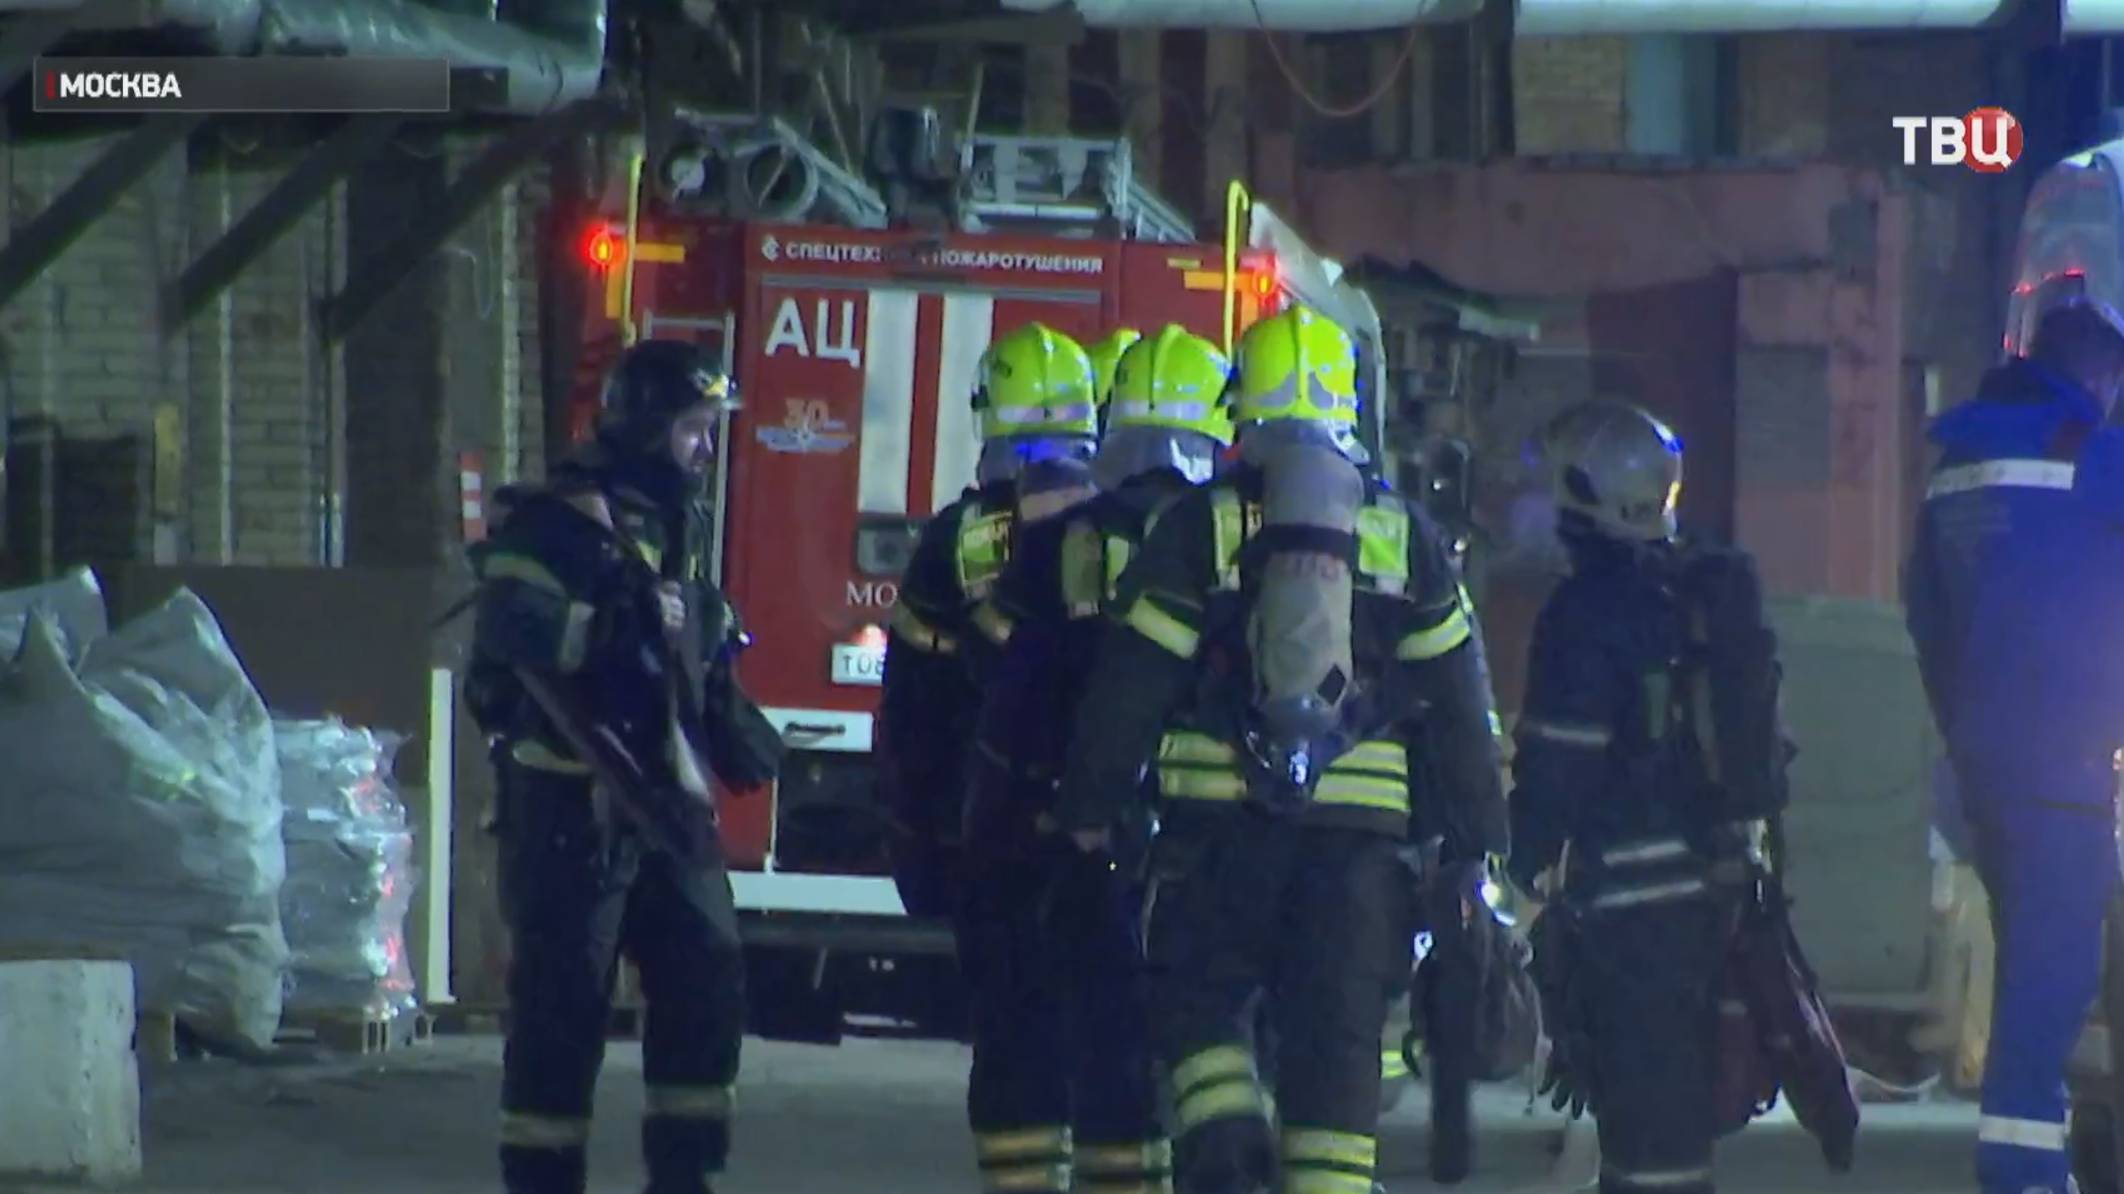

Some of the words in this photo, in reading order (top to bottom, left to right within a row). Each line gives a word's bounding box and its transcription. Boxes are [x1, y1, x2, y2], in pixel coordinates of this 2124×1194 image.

[786, 241, 926, 262] СПЕЦТЕХ
[765, 298, 860, 368] АЦ
[846, 580, 898, 608] МО
